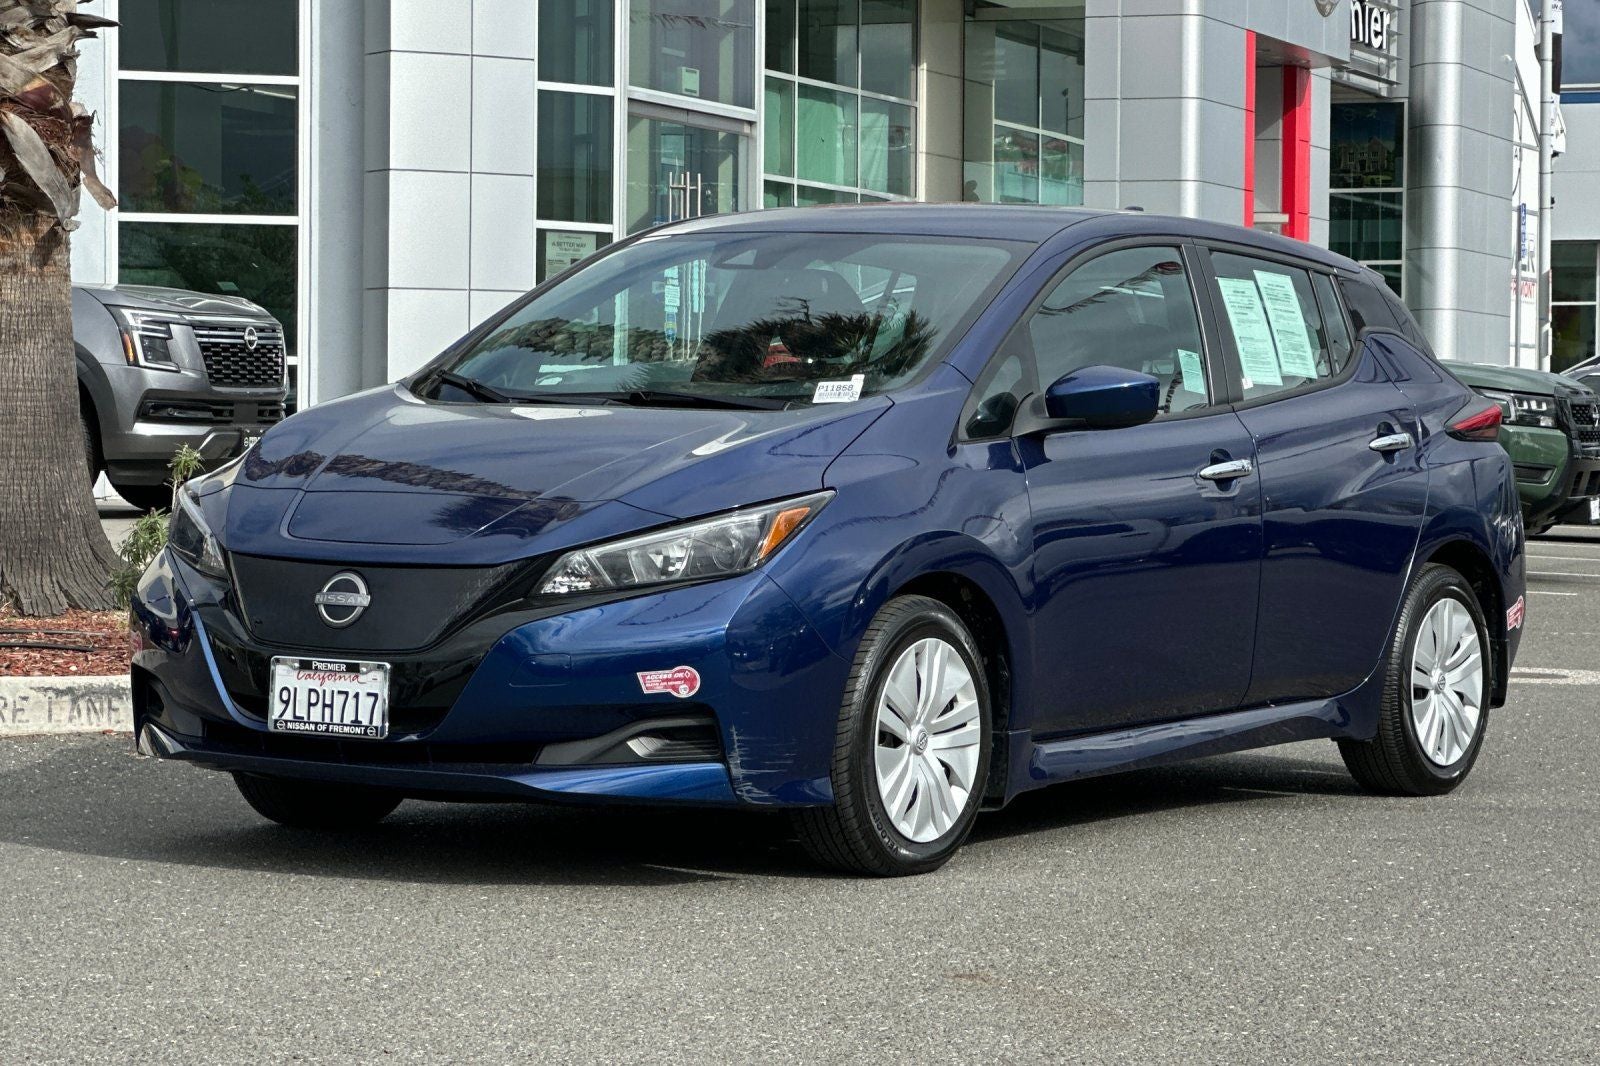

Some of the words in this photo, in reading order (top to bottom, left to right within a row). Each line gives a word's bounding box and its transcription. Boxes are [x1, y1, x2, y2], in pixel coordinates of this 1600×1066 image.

[316, 594, 367, 605] NISSAN
[312, 661, 347, 672] PREMIER
[296, 671, 366, 687] California
[278, 686, 379, 725] 9LPH717
[287, 722, 315, 732] NISSAN
[317, 723, 327, 732] OF
[329, 724, 365, 735] FREMONT
